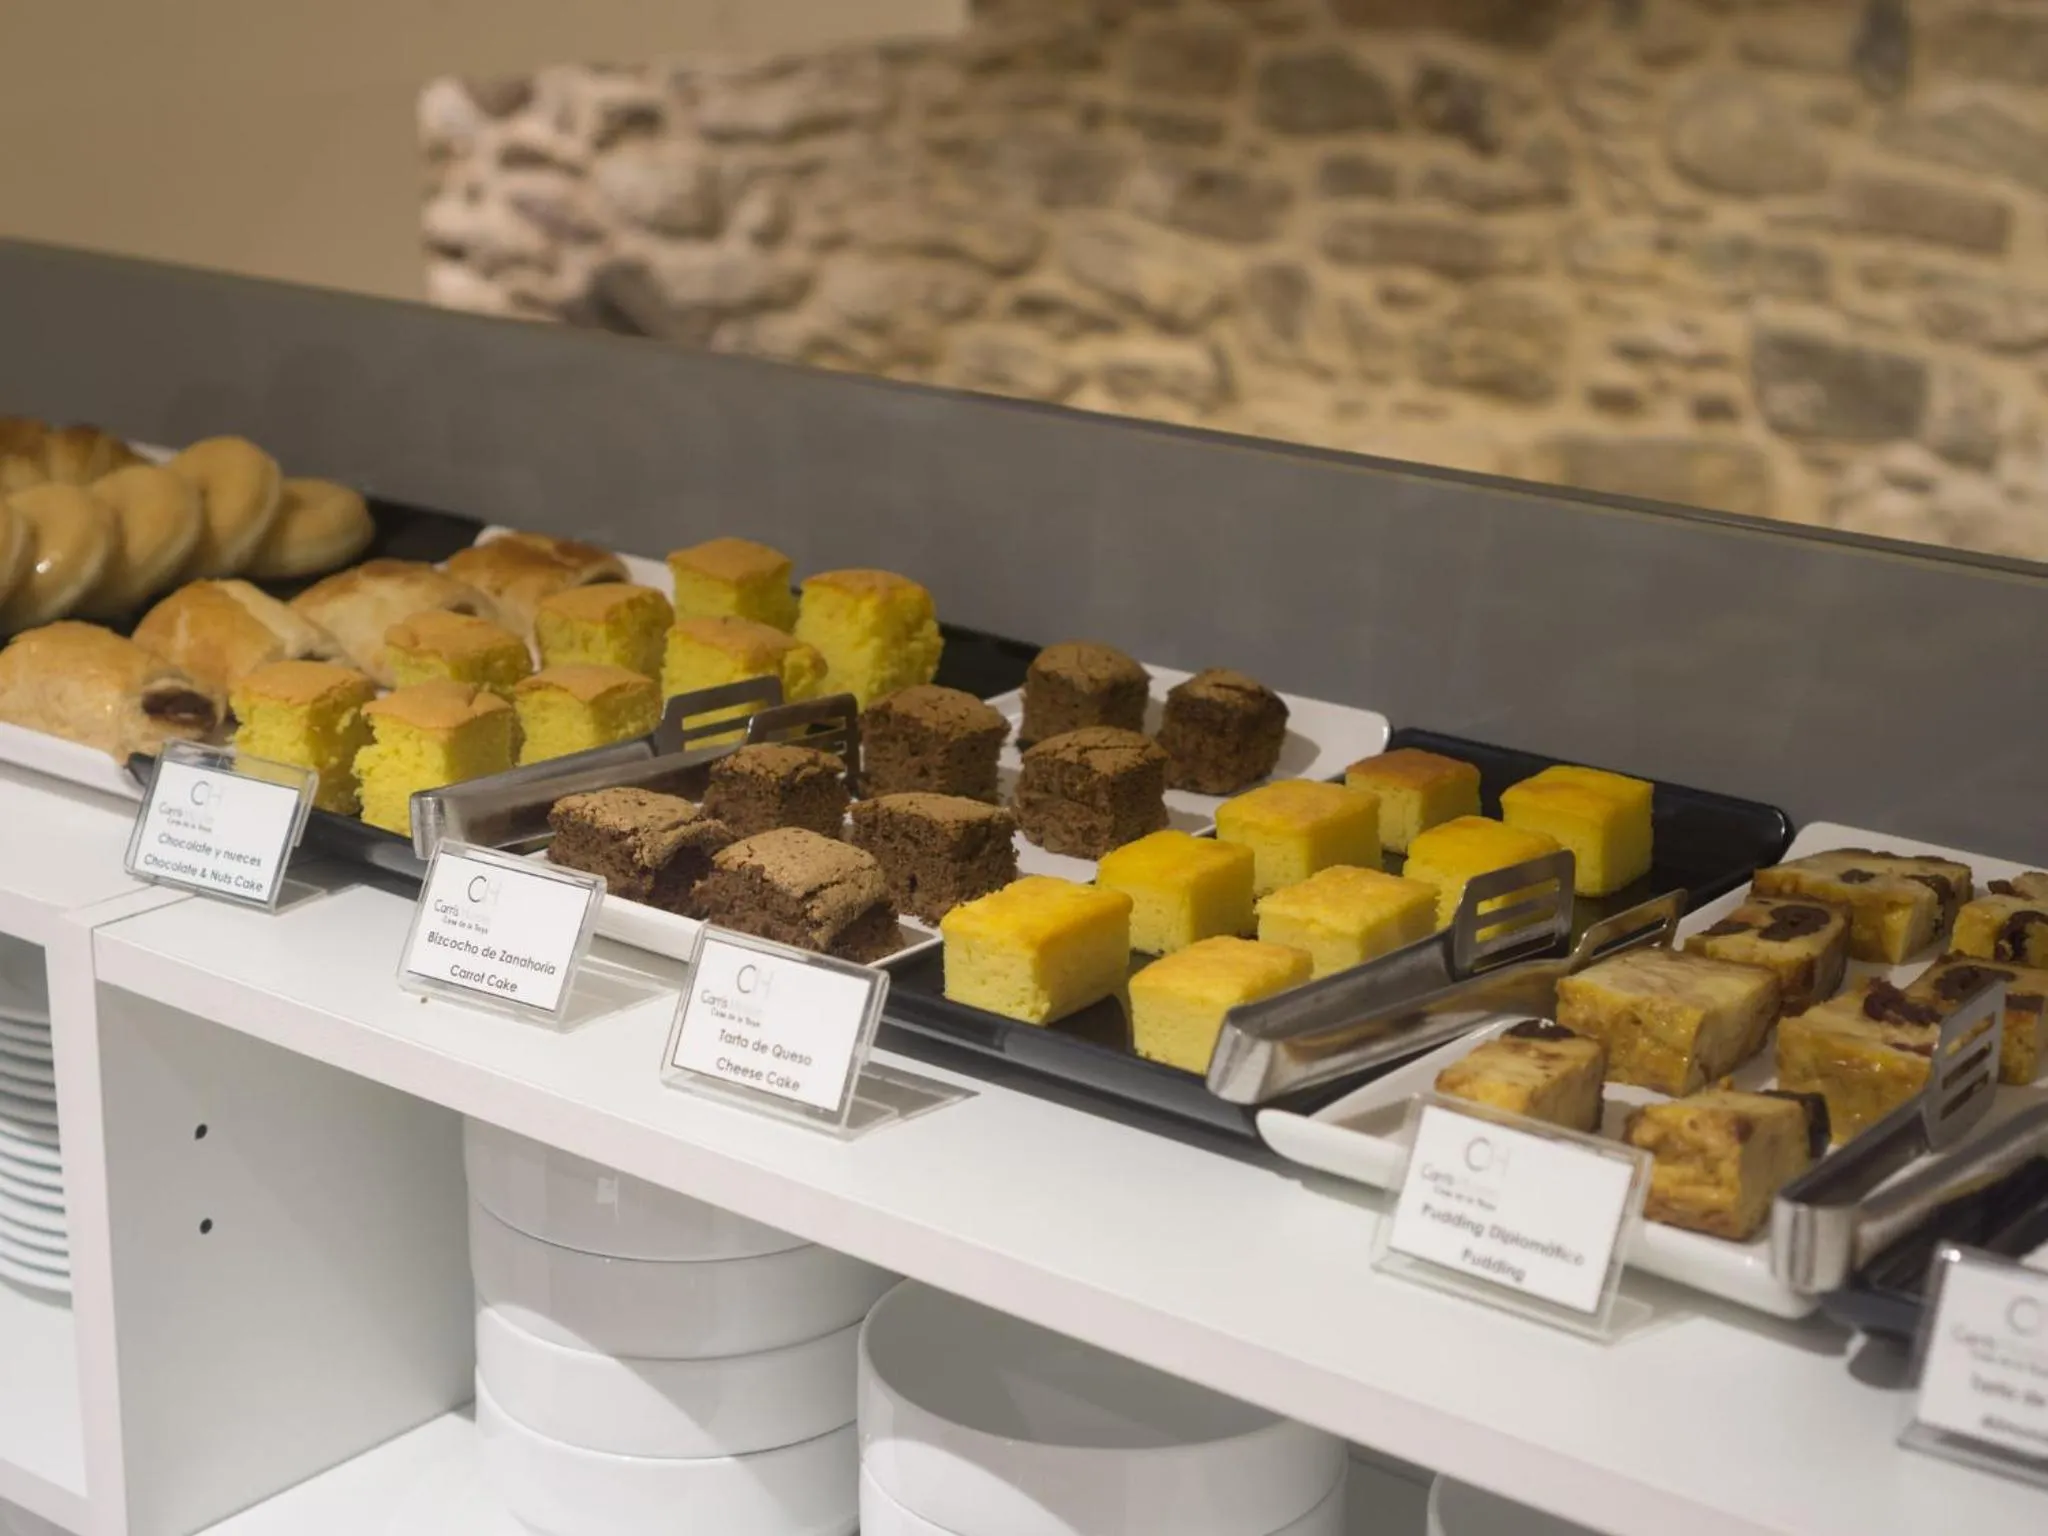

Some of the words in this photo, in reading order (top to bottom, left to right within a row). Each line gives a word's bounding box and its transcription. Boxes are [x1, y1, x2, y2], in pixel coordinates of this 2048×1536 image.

[158, 833, 212, 856] Chocolate
[214, 849, 222, 860] y
[223, 850, 262, 867] nueces
[144, 854, 198, 877] Chocolate
[199, 867, 207, 878] &
[210, 869, 232, 885] Nuts
[233, 875, 263, 893] Cake
[427, 930, 478, 955] Bizcocho
[481, 945, 497, 960] de
[498, 950, 556, 975] Zanahoria
[450, 964, 485, 984] Carrot
[487, 973, 517, 993] Cake
[719, 1029, 749, 1049] Tarta
[751, 1038, 769, 1054] de
[772, 1043, 813, 1067] Queso
[716, 1057, 763, 1081] Cheese
[766, 1071, 800, 1092] Cake
[1421, 1202, 1485, 1238] Pudding
[1461, 1247, 1527, 1283] Pudding
